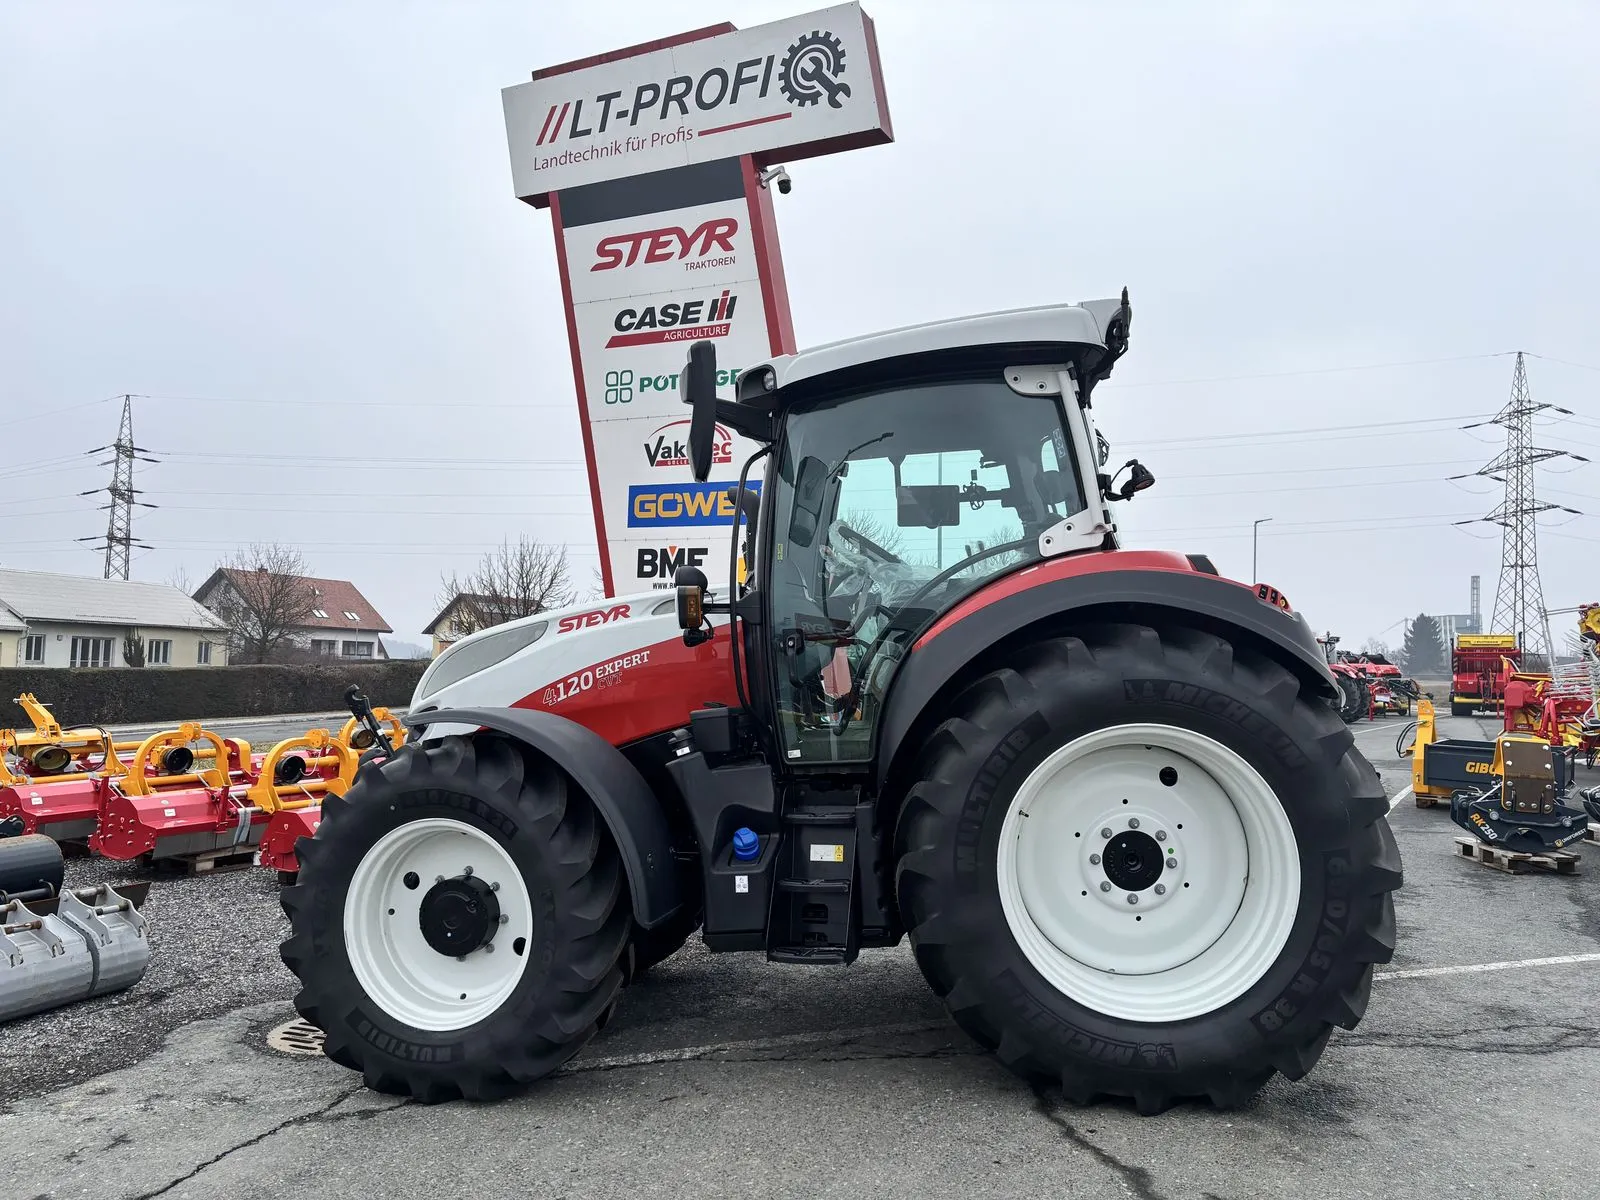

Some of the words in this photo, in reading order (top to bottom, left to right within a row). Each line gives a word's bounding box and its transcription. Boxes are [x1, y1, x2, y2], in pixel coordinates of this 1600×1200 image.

[533, 139, 622, 171] Landtechnik
[625, 136, 647, 153] für
[650, 126, 693, 148] Profis
[590, 217, 738, 272] STEYR
[685, 256, 736, 271] TRAKTOREN
[614, 300, 704, 332] CASE
[663, 325, 727, 341] AGRICULTURE
[644, 435, 732, 467] Vakec
[557, 604, 631, 634] STEYR
[596, 650, 650, 678] EXPERT
[542, 671, 593, 706] 4120
[598, 671, 623, 689] CVT
[1470, 812, 1498, 840] RK250
